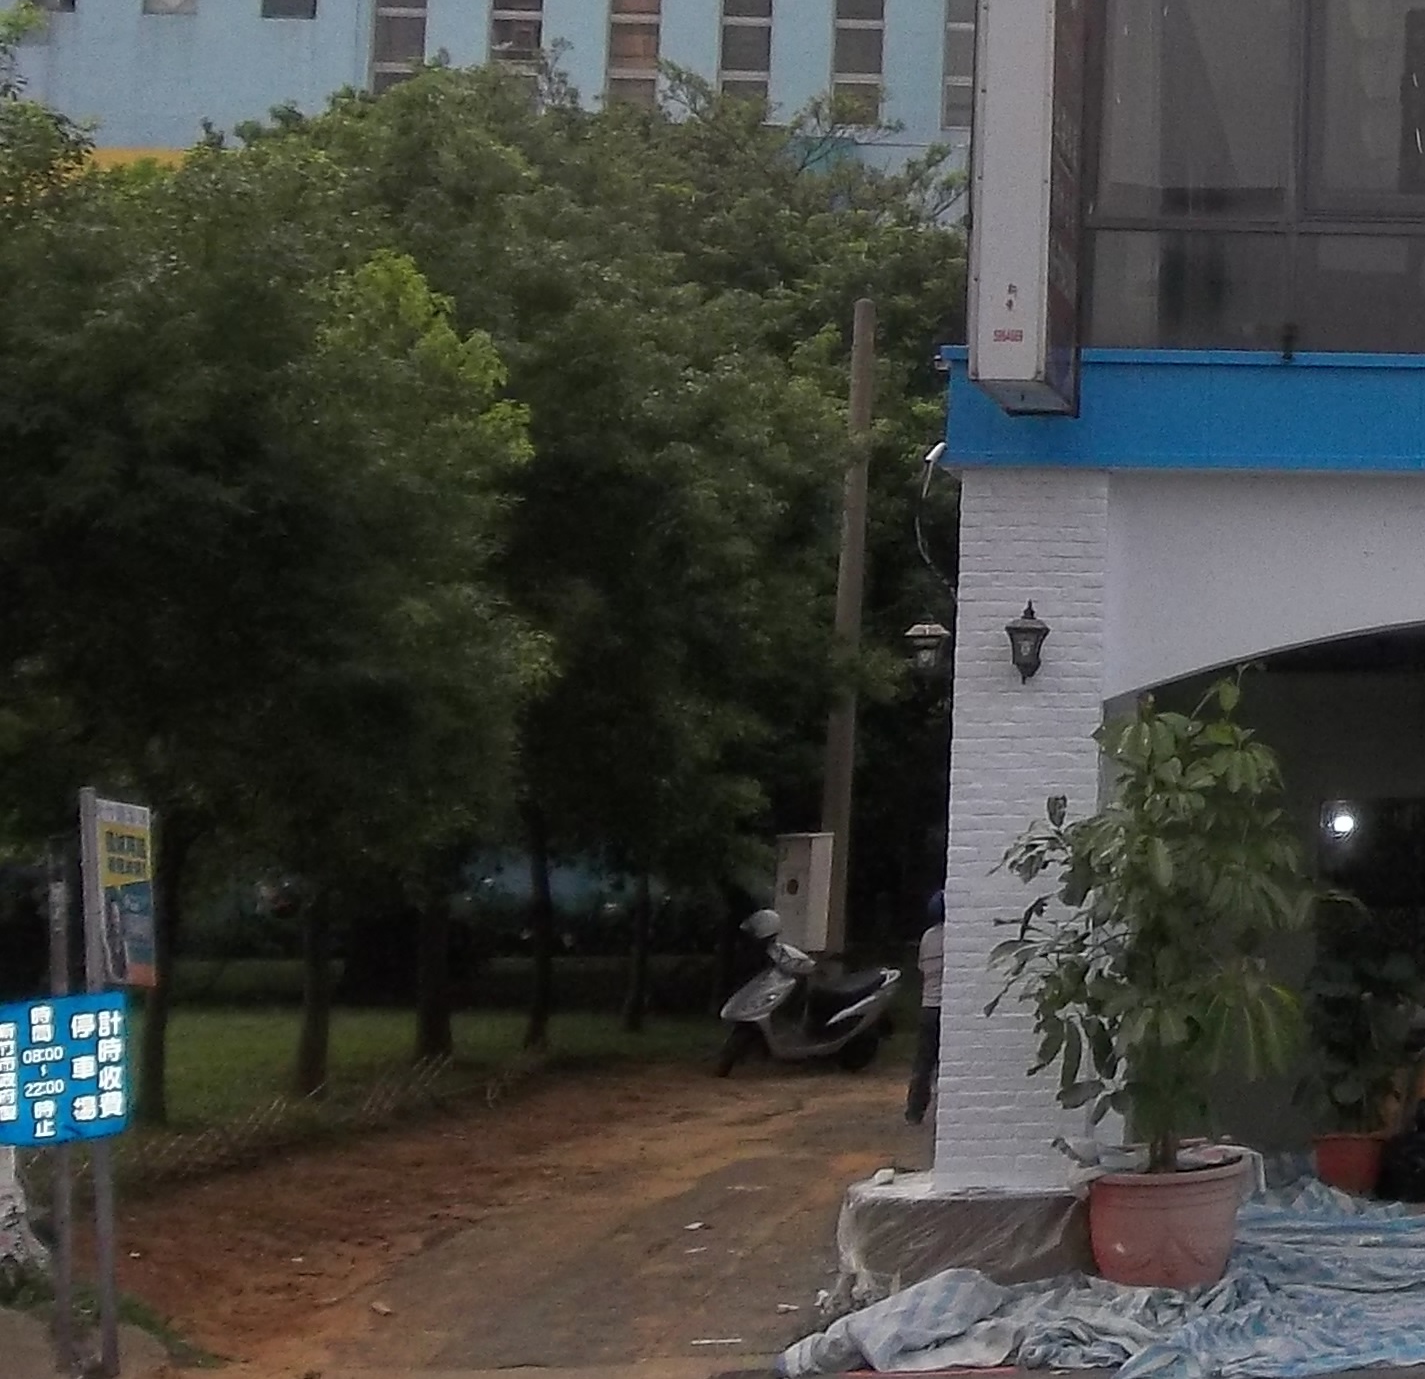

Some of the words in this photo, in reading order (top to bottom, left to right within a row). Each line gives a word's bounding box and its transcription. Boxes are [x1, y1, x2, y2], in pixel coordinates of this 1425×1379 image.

[22, 1046, 64, 1065] 08:00
[71, 1013, 98, 1121] 停車場
[98, 1010, 123, 1118] 計時收費
[24, 1079, 65, 1098] 22:00
